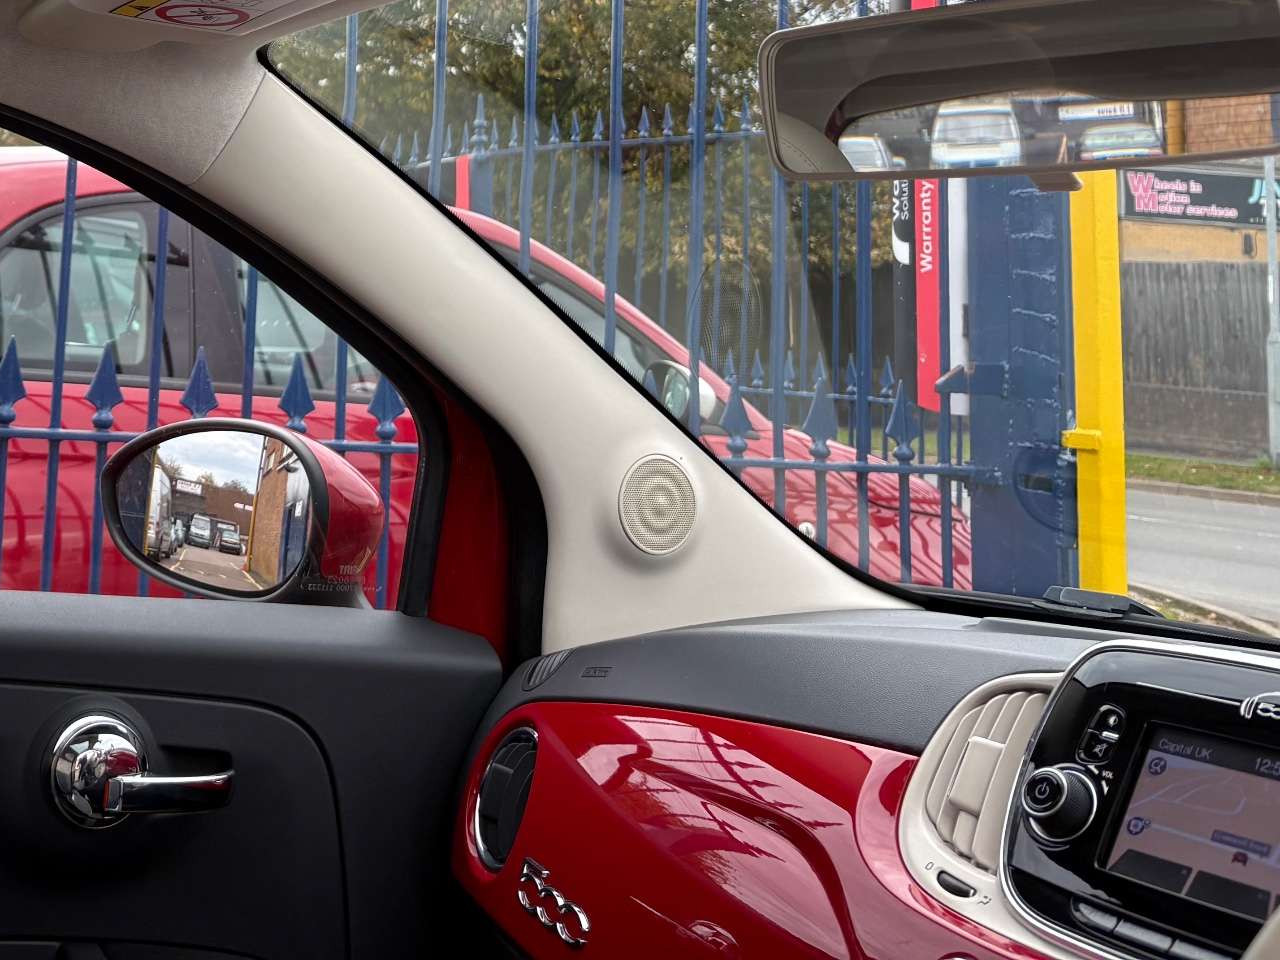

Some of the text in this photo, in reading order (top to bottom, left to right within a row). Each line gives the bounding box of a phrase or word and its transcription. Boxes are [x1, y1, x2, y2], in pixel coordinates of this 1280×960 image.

[919, 180, 935, 273] Warranty
[1101, 771, 1114, 779] VOL
[1195, 747, 1214, 760] UK
[517, 856, 593, 946] 500
